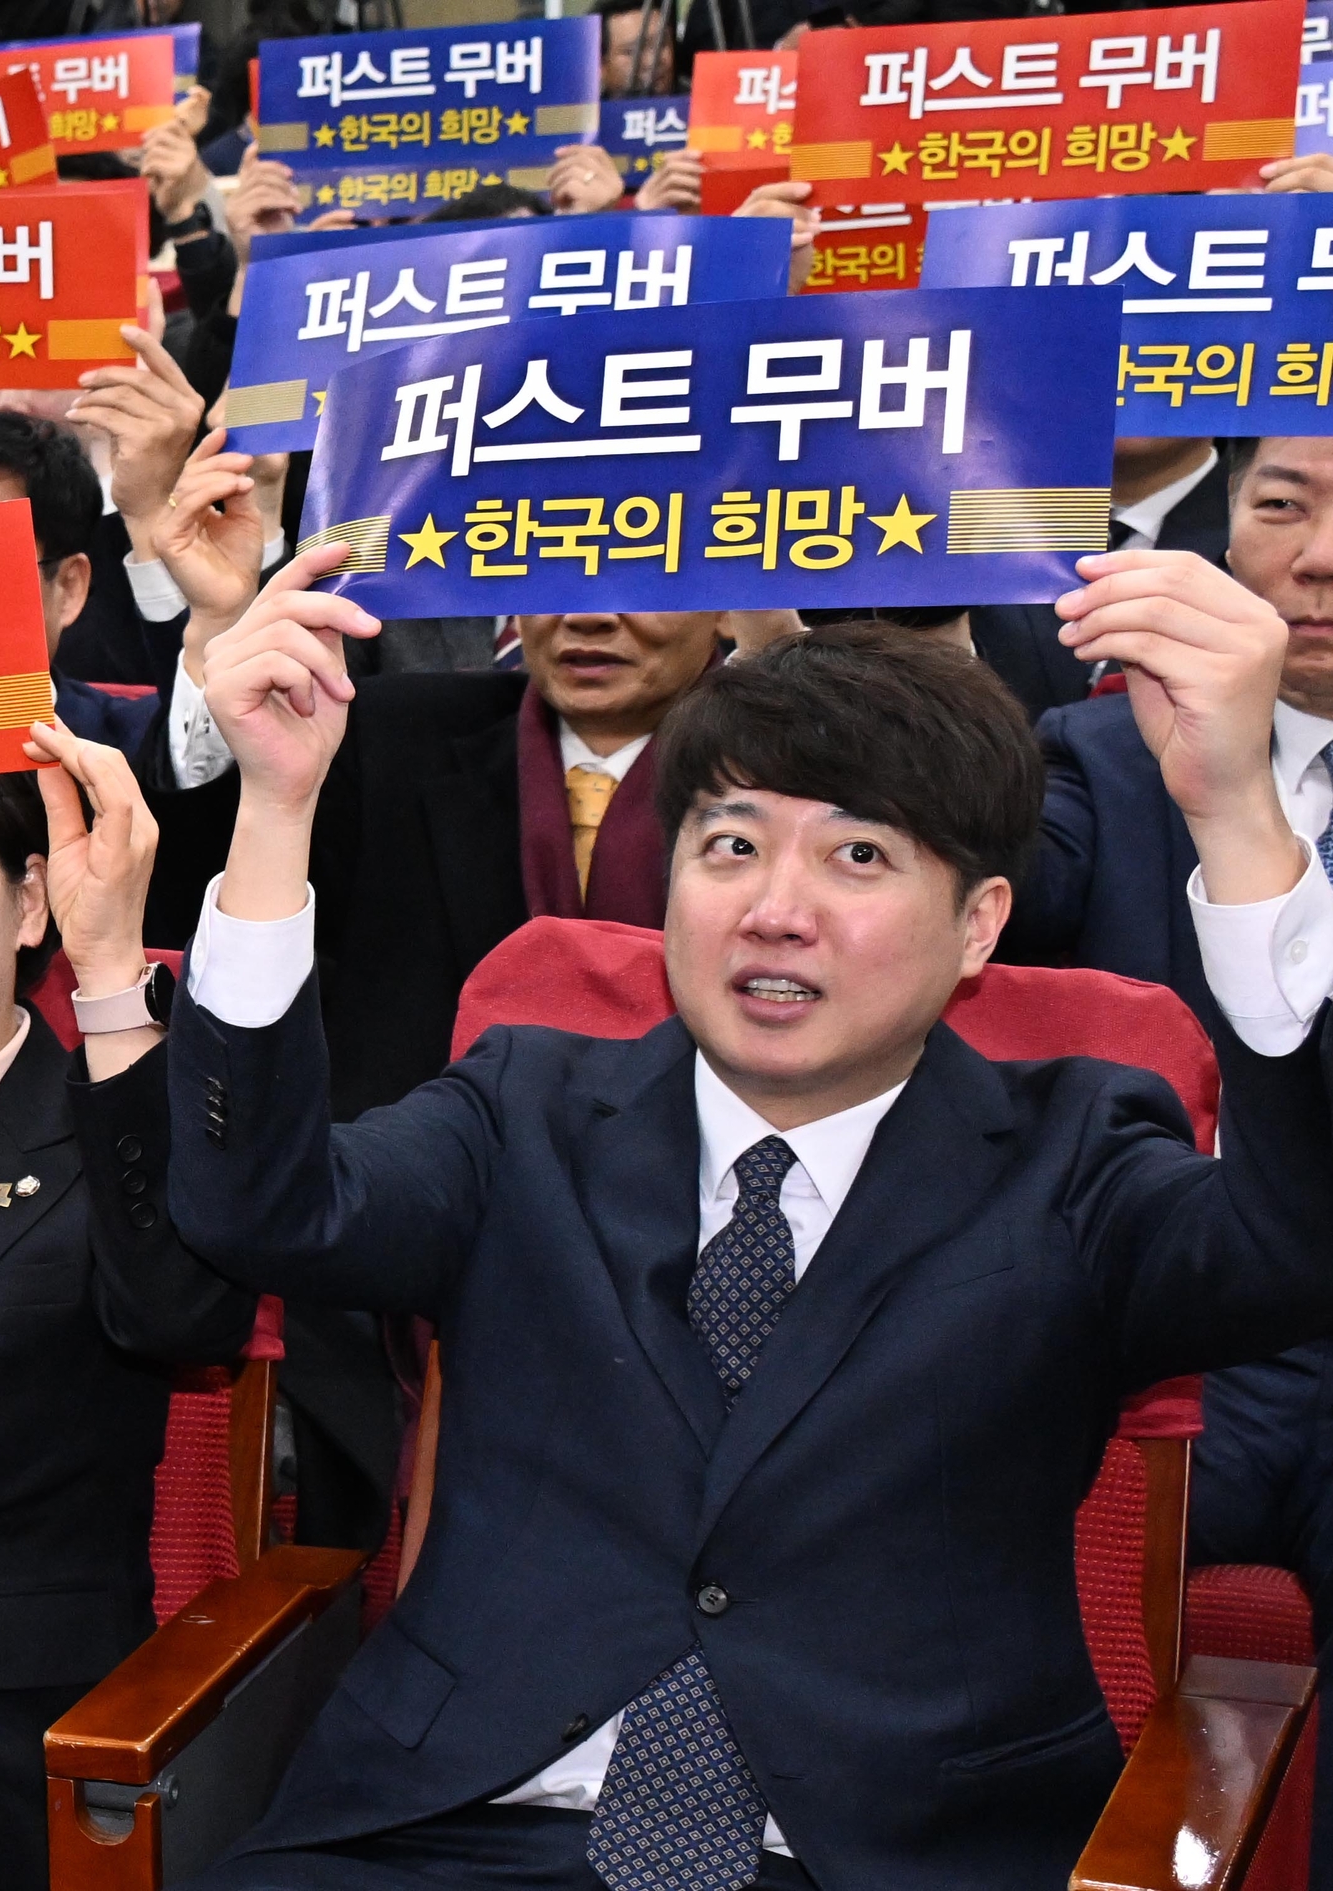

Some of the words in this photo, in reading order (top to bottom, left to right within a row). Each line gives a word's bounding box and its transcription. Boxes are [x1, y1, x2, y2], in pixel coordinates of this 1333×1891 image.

[51, 53, 130, 103] 무버
[297, 47, 436, 107] 퍼스트
[444, 37, 542, 98] 무버
[859, 42, 1064, 120] 퍼스트
[1079, 28, 1221, 109] 무버
[338, 111, 431, 152] 한국의
[438, 106, 502, 146] 희망
[621, 107, 688, 146] 퍼스
[918, 126, 1052, 180] 한국의
[1062, 122, 1158, 174] 희망
[338, 167, 417, 204] 한국의
[297, 256, 511, 353] 퍼스트
[1008, 230, 1272, 314] 퍼스트
[379, 348, 702, 477] 퍼스트
[728, 329, 973, 462] 무버
[1117, 342, 1255, 407] 국의
[1269, 342, 1333, 407] 희
[462, 491, 684, 577] 한국의
[703, 486, 865, 570] 희망
